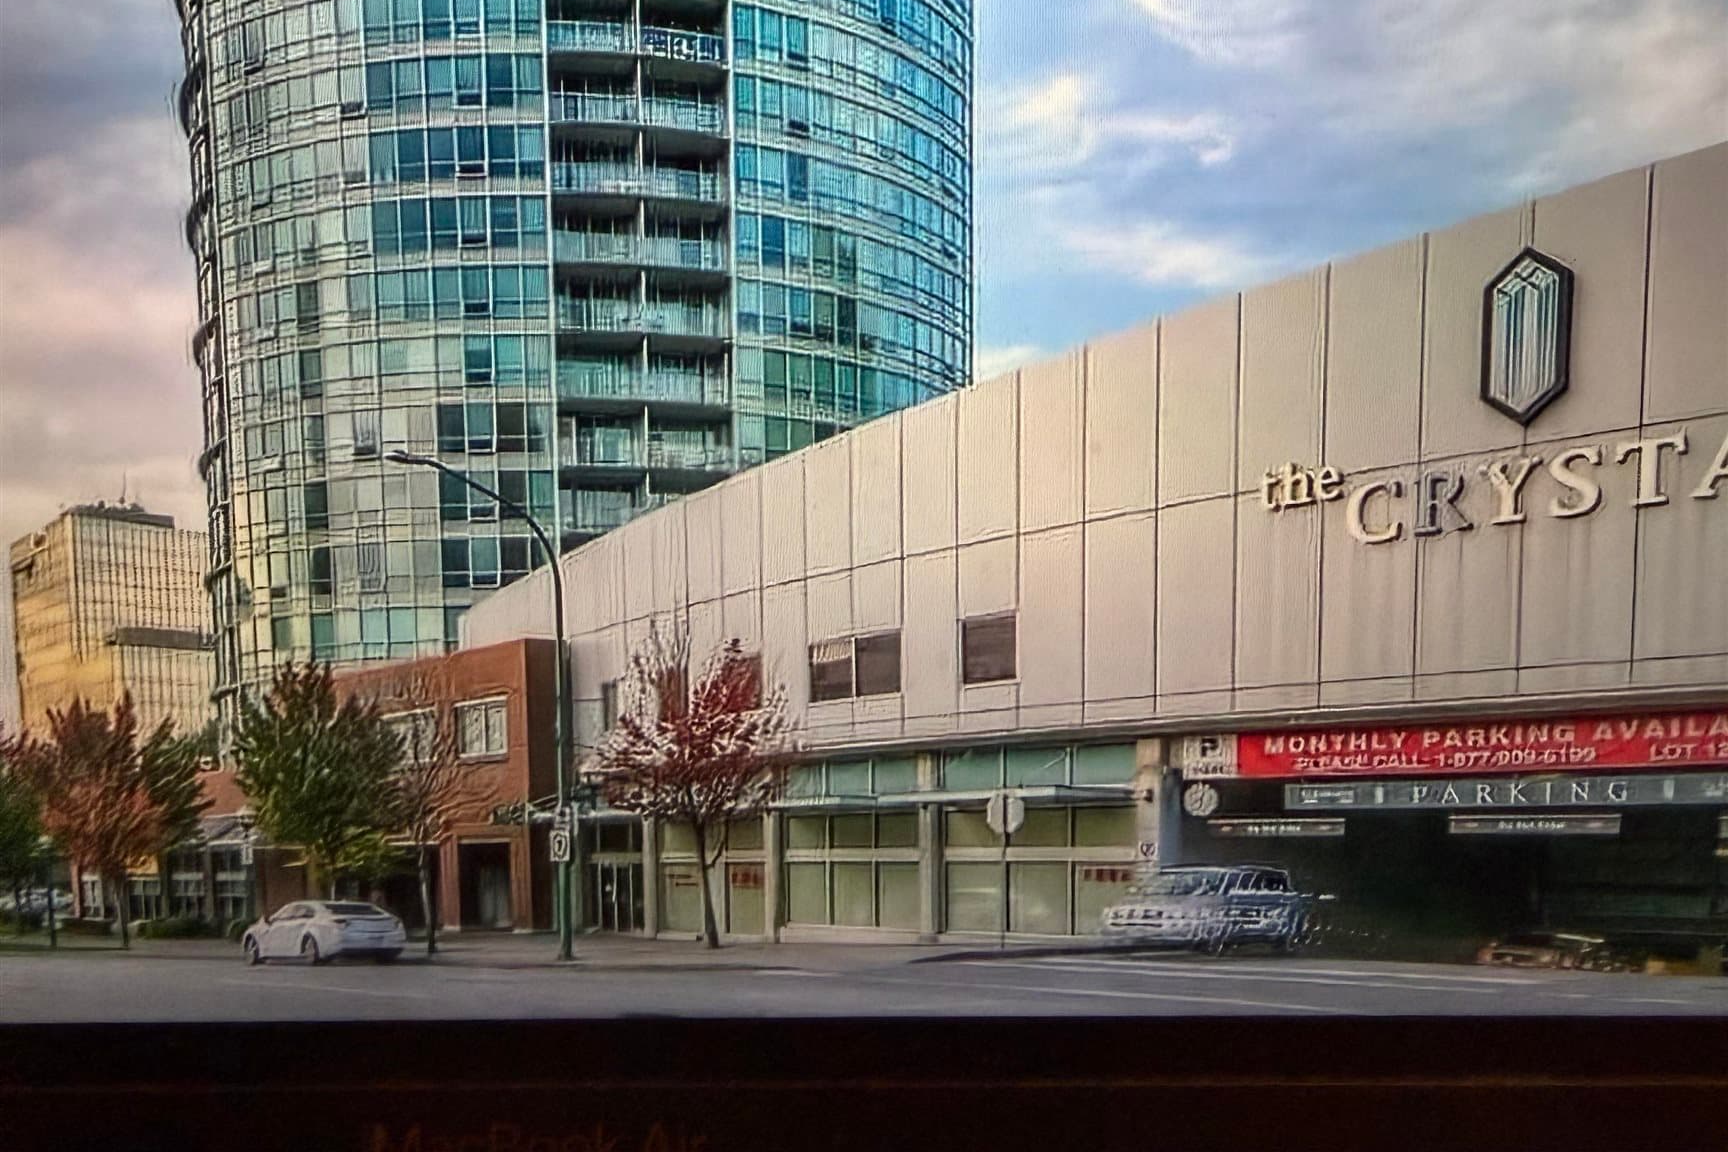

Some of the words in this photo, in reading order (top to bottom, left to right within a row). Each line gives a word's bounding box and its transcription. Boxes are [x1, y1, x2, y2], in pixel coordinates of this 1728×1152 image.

[1261, 461, 1344, 512] the
[1264, 731, 1408, 755] MONTHLY
[1423, 724, 1576, 748] PARKING
[1592, 715, 1728, 741] AVAILA
[1649, 744, 1697, 761] LOT
[1412, 780, 1628, 805] PARKING
[366, 1120, 620, 1152] MacBook
[643, 1120, 706, 1152] Air
